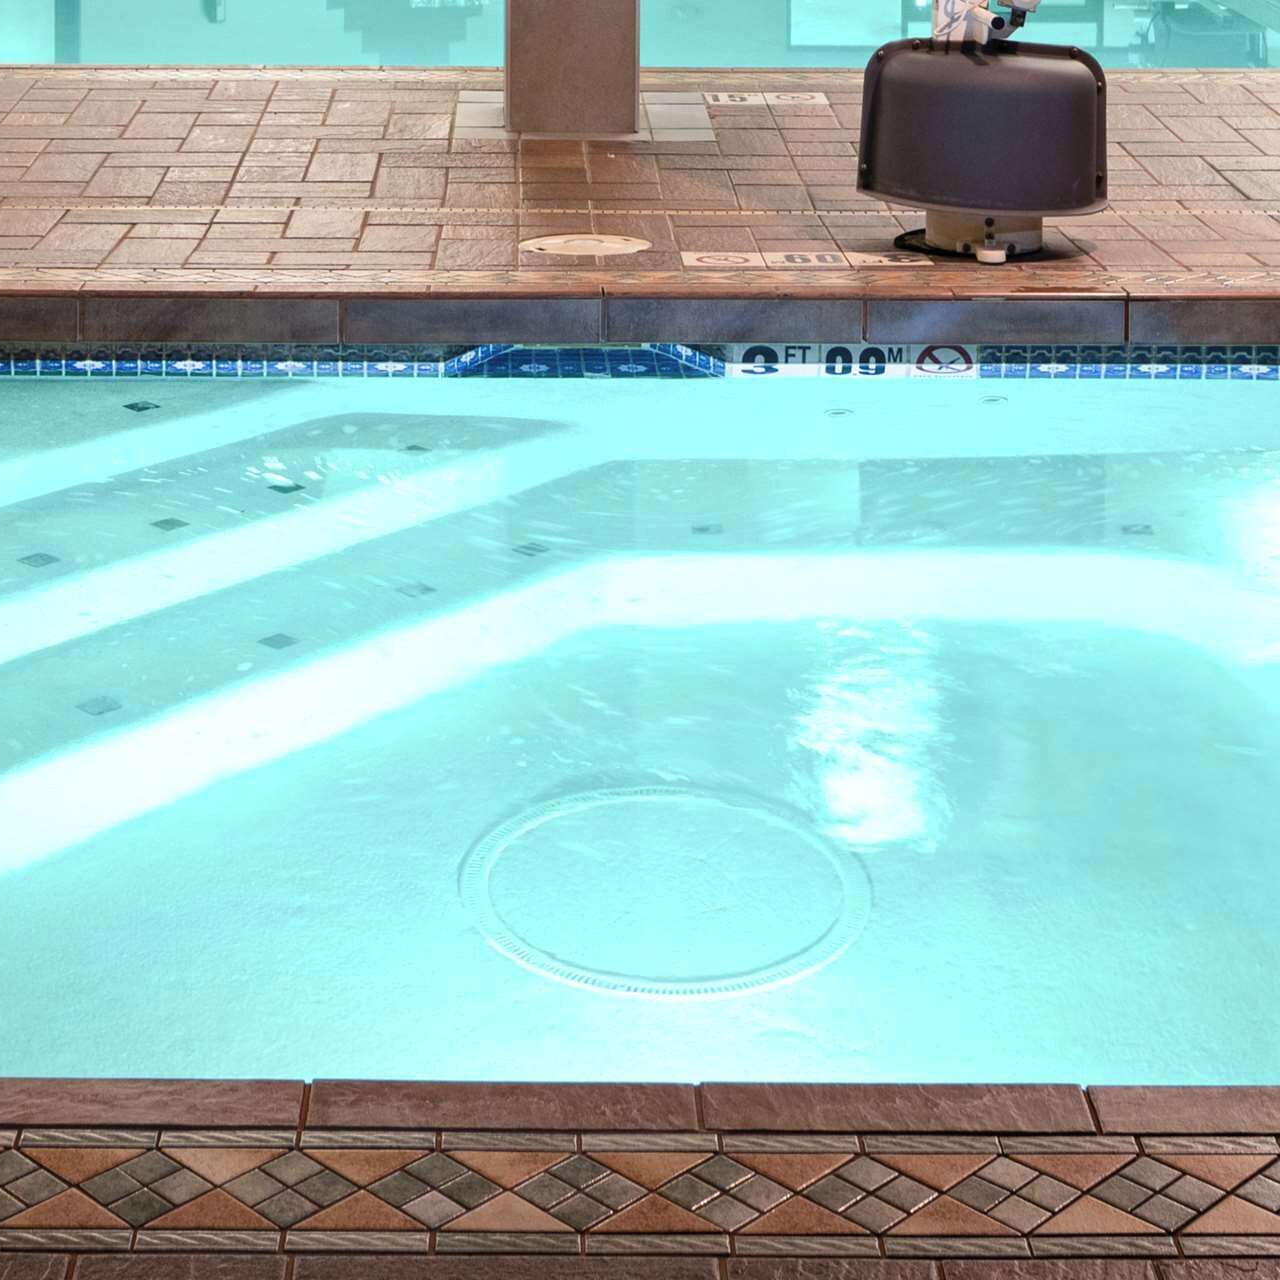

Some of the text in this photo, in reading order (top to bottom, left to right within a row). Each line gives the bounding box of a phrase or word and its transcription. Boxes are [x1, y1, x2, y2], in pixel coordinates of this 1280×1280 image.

[741, 345, 779, 375] 3
[784, 346, 811, 364] FT
[888, 347, 903, 363] M
